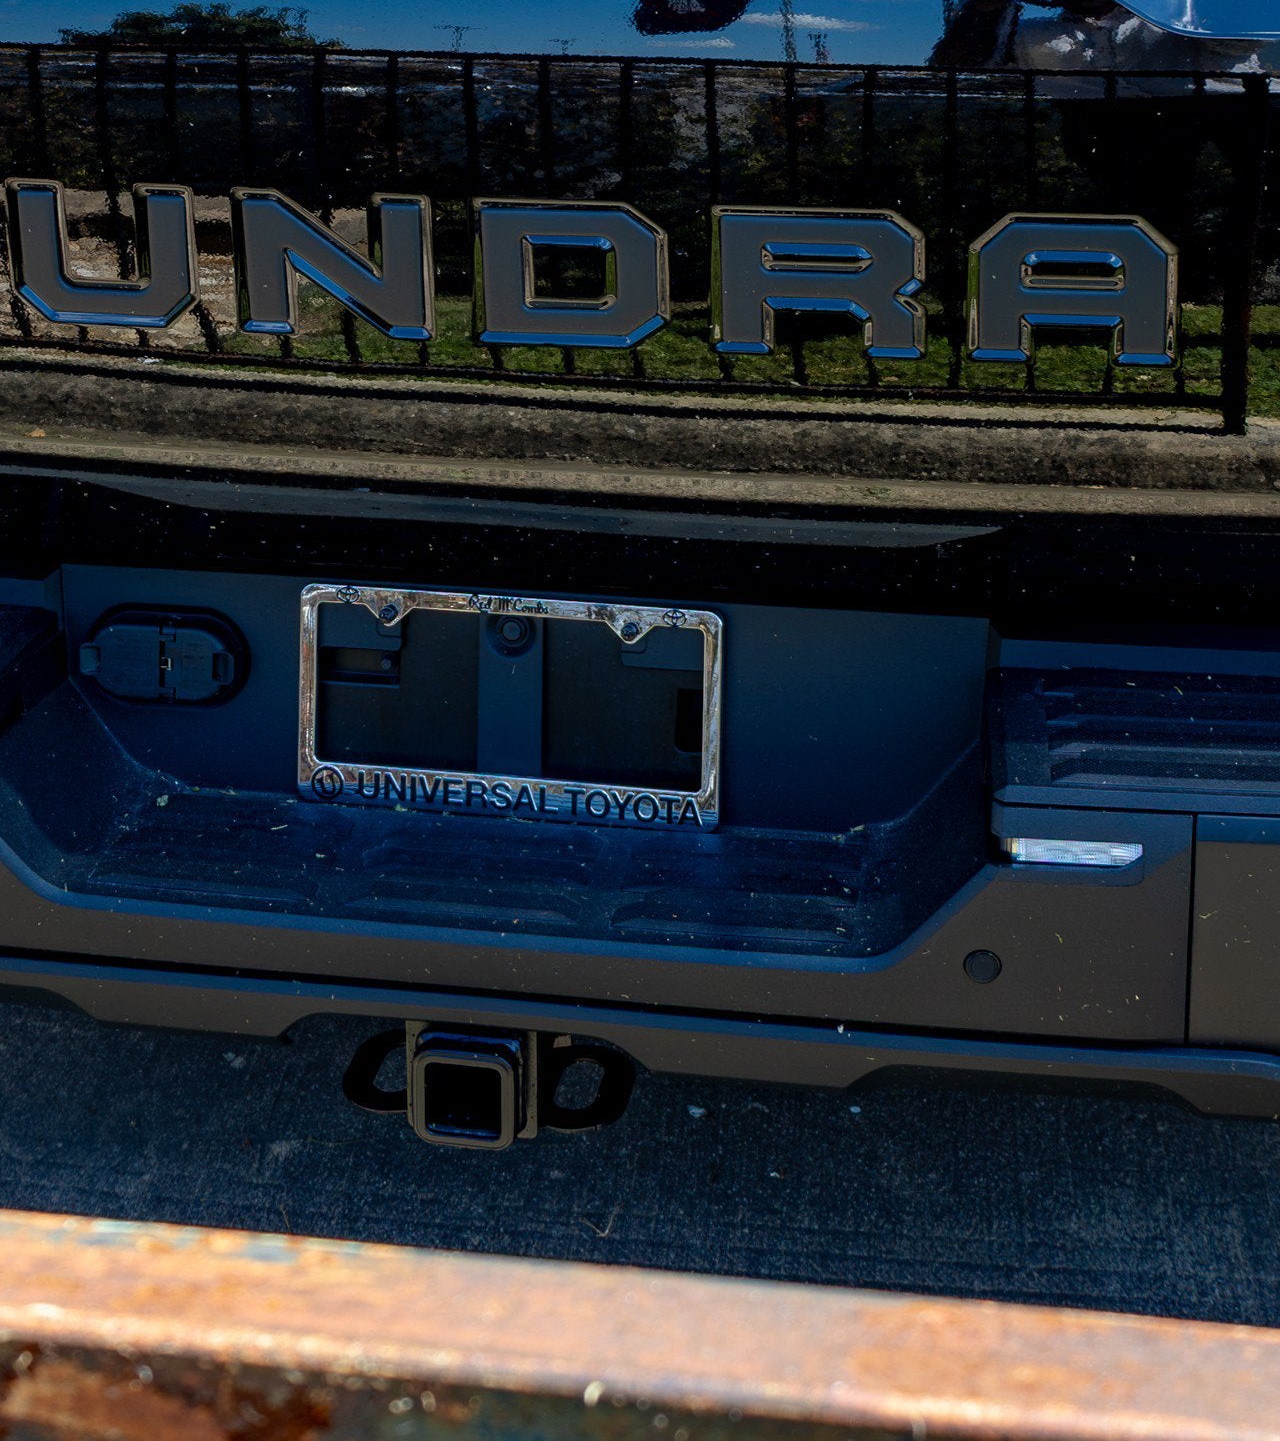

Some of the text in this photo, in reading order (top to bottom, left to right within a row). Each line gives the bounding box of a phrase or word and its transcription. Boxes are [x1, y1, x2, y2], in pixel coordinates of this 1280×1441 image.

[468, 593, 493, 614] Red
[356, 769, 559, 816] UNIVERSAL
[565, 787, 703, 827] TOYOTA
